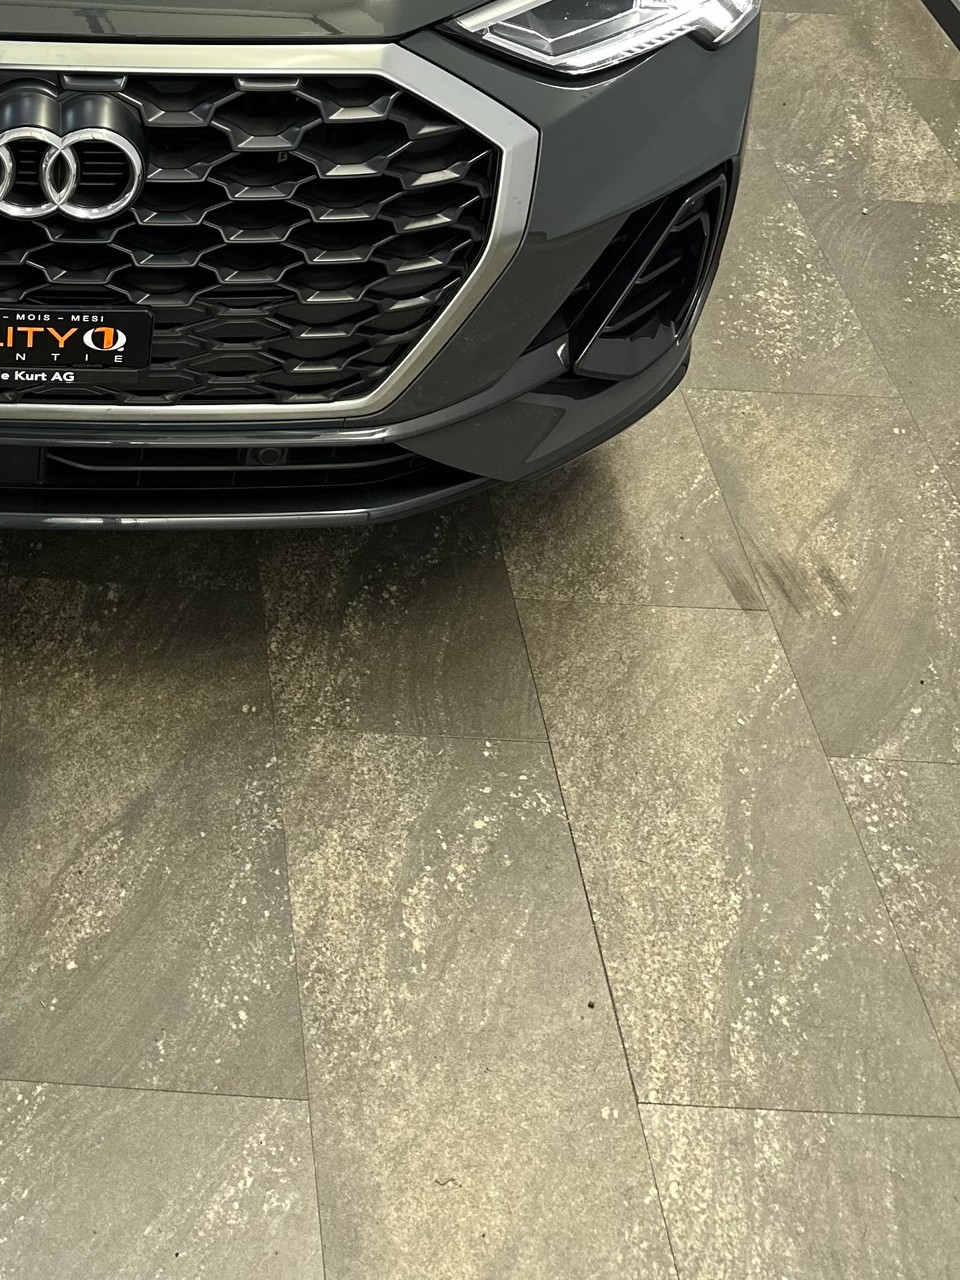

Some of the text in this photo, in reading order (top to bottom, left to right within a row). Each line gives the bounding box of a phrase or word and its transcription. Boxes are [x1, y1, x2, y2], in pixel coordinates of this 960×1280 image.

[16, 313, 51, 322] MOIS
[71, 315, 104, 323] MESI
[14, 371, 47, 382] Kurt
[51, 371, 75, 382] AG
